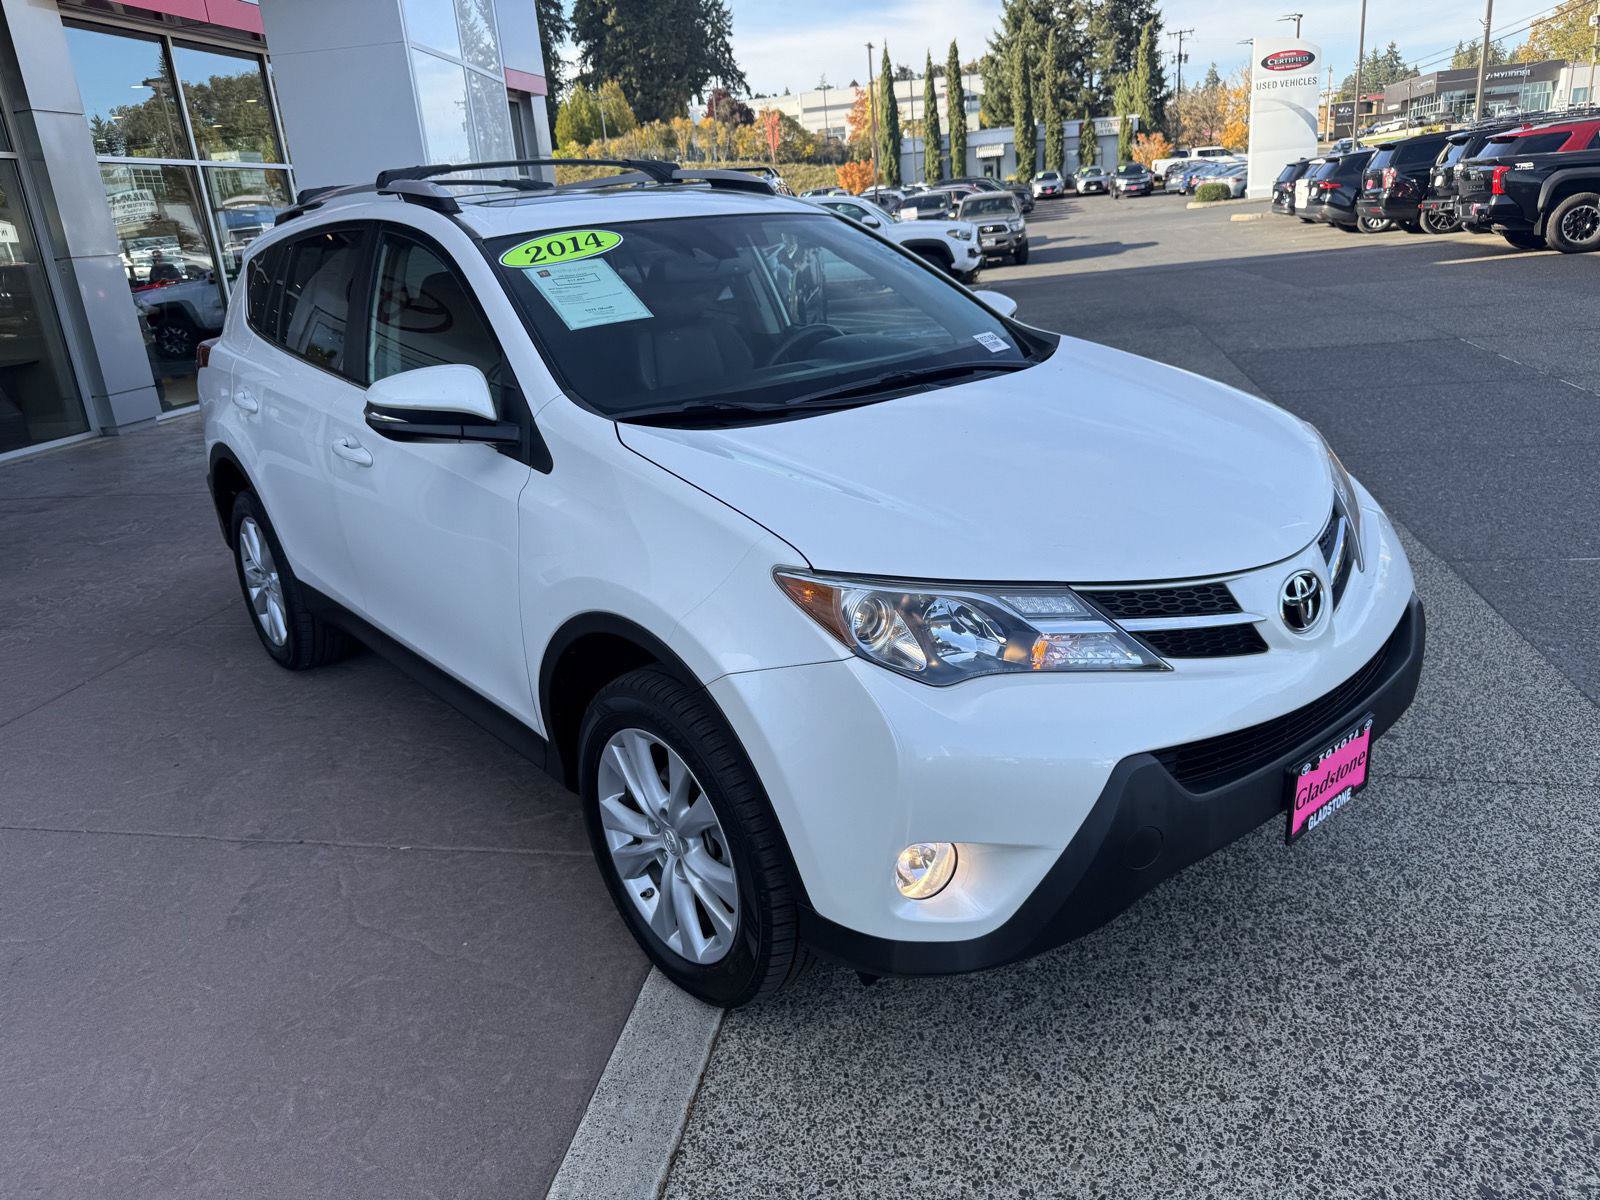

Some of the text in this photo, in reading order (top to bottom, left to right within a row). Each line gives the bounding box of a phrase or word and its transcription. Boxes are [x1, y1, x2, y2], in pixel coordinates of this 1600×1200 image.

[1267, 55, 1309, 66] CERTIFIED
[1256, 76, 1318, 91] USED VEHICLES
[524, 232, 605, 264] 2014
[1318, 729, 1360, 762] TOYOTA
[1295, 750, 1366, 811] Gladstone
[1307, 786, 1353, 831] GLADSTONE
